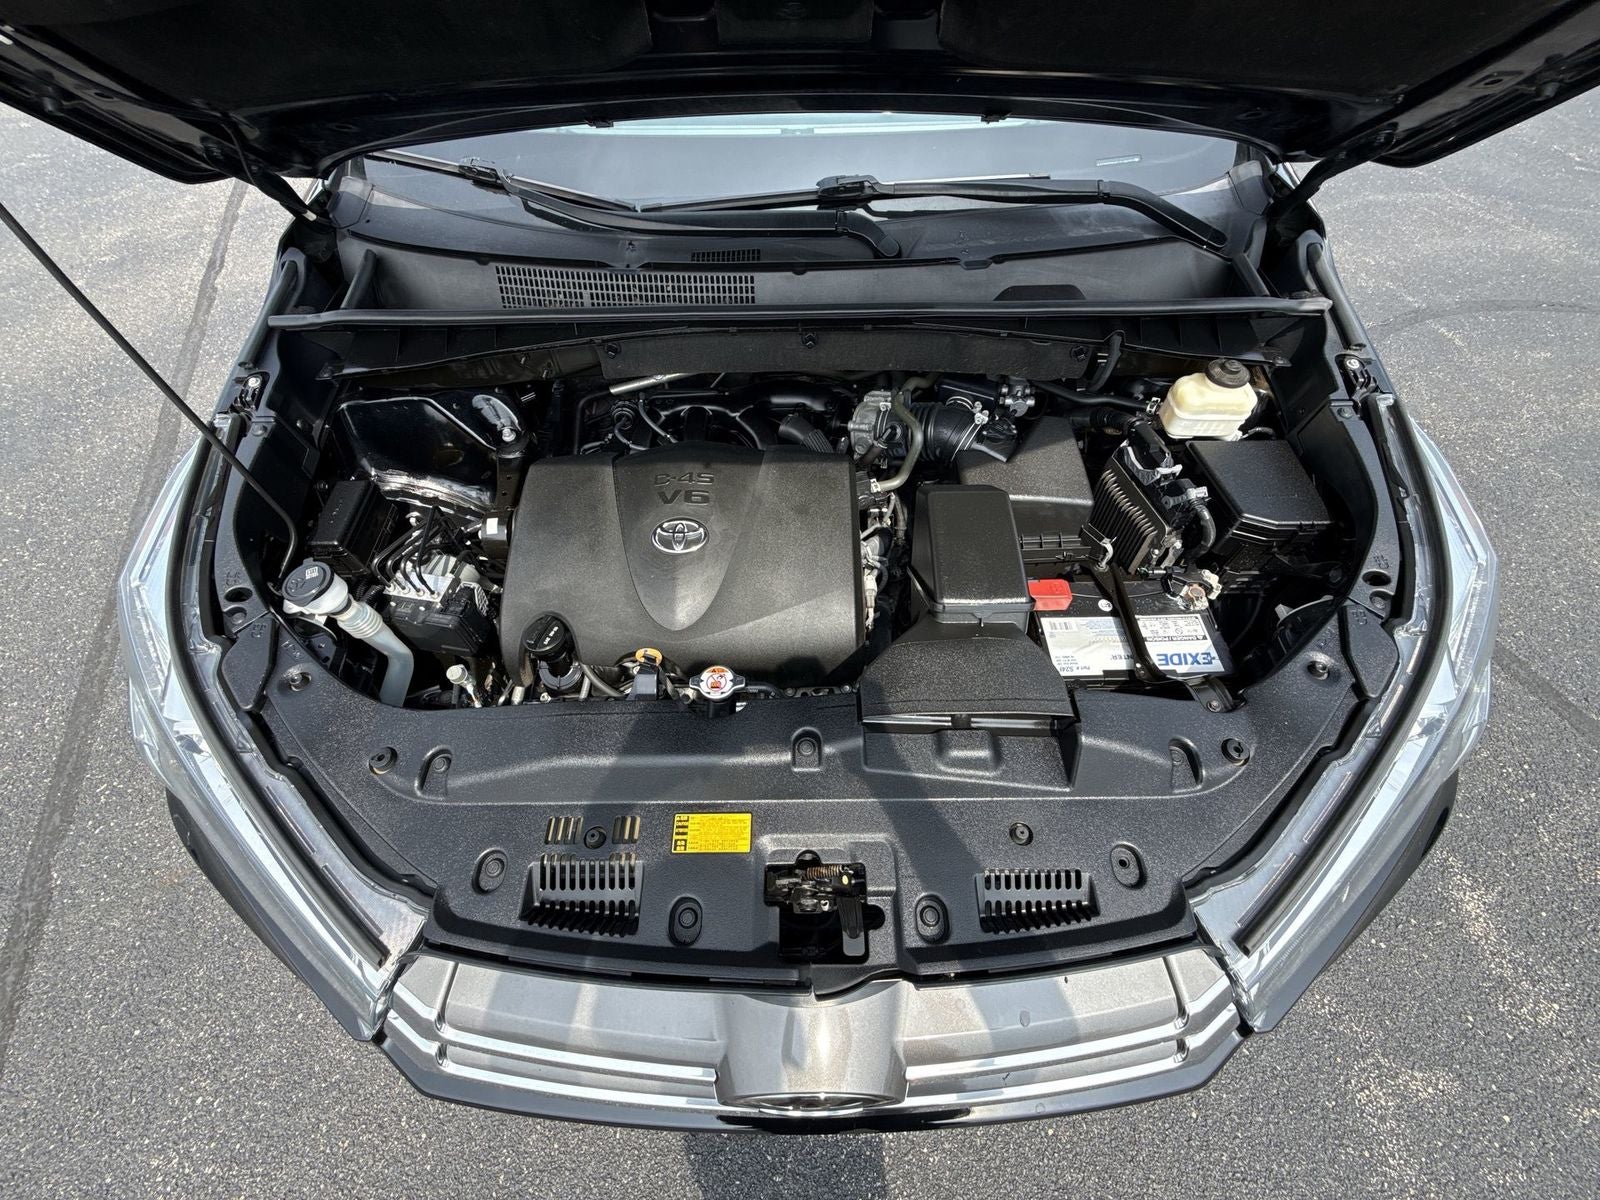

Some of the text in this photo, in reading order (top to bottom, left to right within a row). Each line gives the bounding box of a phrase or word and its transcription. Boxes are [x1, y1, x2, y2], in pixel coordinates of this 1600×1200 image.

[655, 472, 715, 487] D-4S
[657, 489, 710, 506] V6
[1156, 652, 1215, 666] EXIDE
